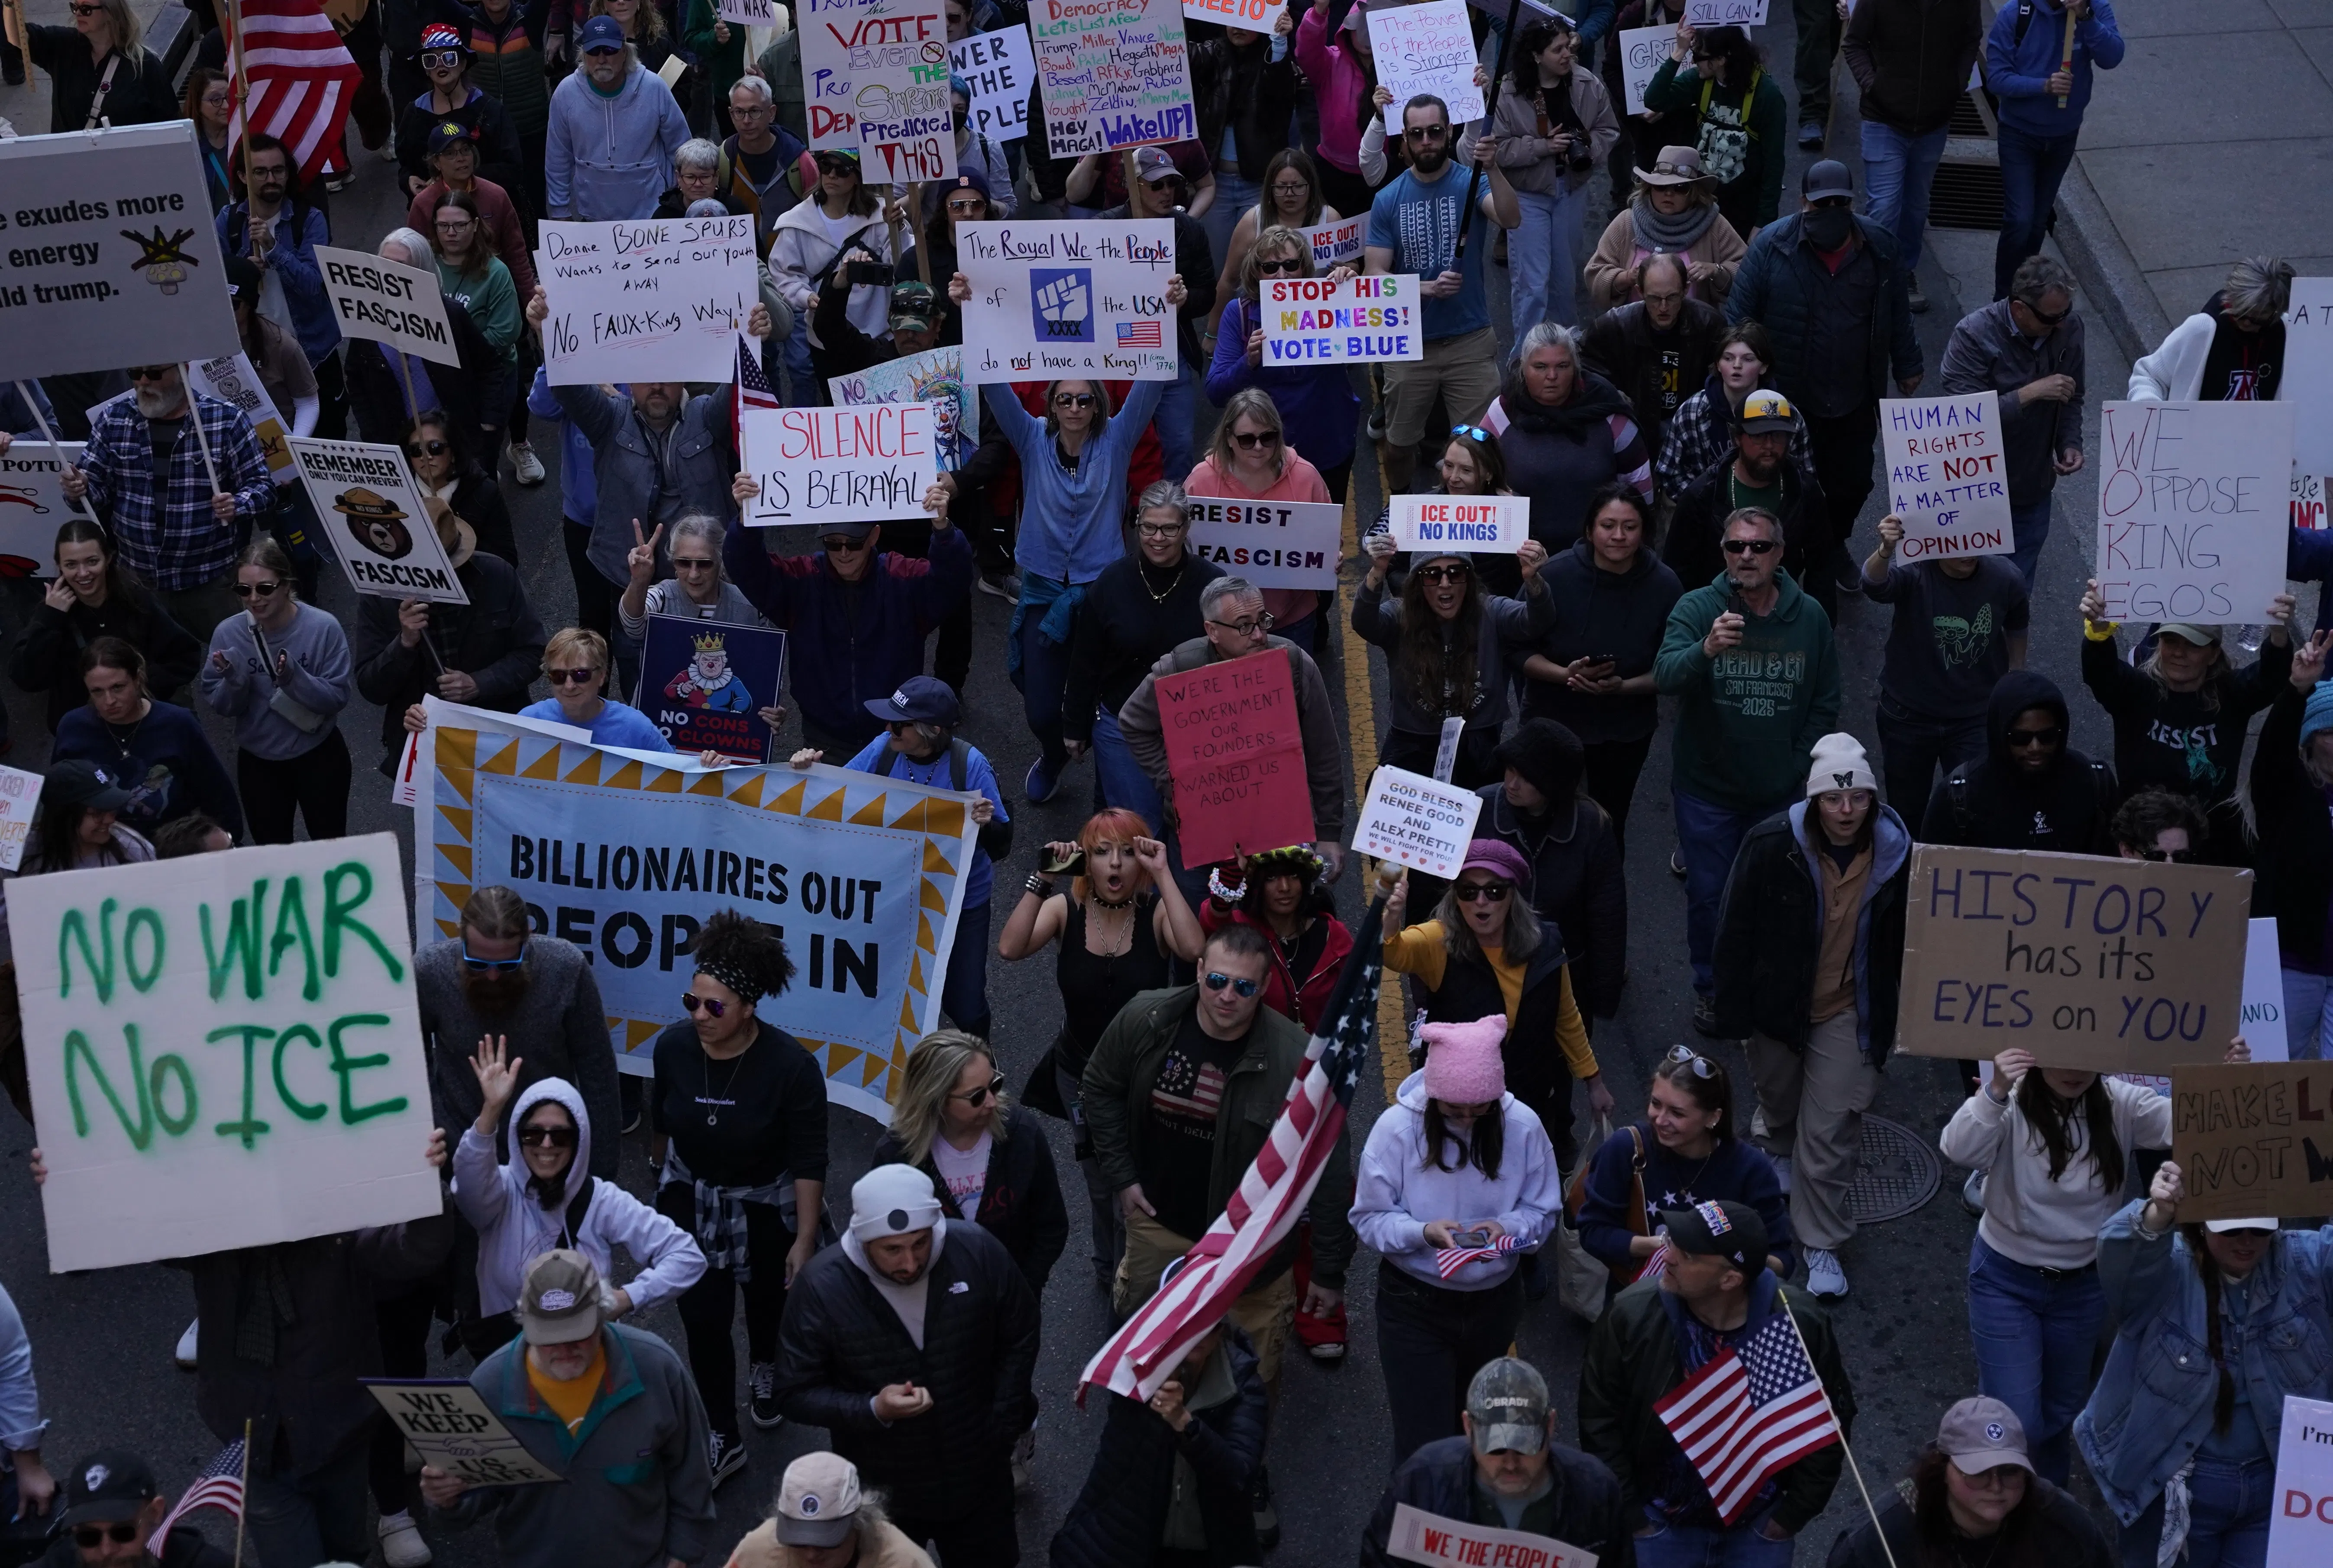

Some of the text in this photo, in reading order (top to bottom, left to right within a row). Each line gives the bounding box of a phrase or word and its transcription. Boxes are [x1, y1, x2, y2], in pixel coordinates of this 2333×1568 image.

[743, 0, 771, 19] WAR
[862, 3, 897, 16] the
[1376, 10, 1465, 33] The Power
[1691, 0, 1761, 21] STILL CAN!
[1035, 41, 1082, 56] Trump,
[1380, 31, 1470, 56] of the People
[849, 45, 920, 71] Even
[1381, 50, 1470, 74] is Stronger
[908, 62, 947, 84] THE
[965, 66, 1017, 97] THE
[1047, 68, 1095, 86] Bessent,
[1145, 74, 1182, 90] Rubio
[1383, 74, 1453, 96] than the
[856, 84, 947, 123] Simpsons
[1443, 87, 1462, 98] in
[1050, 120, 1087, 137] Hey
[1051, 131, 1102, 154] MAGA!
[15, 193, 184, 227] exudes more
[547, 219, 747, 260] Donnie BONE SPURS
[1313, 222, 1358, 247] ICE OUT!
[8, 242, 99, 267] energy
[964, 229, 1173, 271] The Royal We the People
[1313, 237, 1359, 261] NO KINGS
[555, 248, 718, 278] Wants to our
[33, 281, 120, 303] trump.
[326, 262, 414, 301] RESIST
[1272, 277, 1398, 302] STOP HIS
[986, 287, 1007, 307] of
[1102, 295, 1167, 316] the USA
[338, 298, 447, 345] FASCISM
[553, 292, 744, 359] No Way!
[1280, 306, 1409, 332] MADNESS!
[981, 348, 998, 371] do
[1011, 352, 1036, 368] not
[1041, 352, 1076, 368] have
[1084, 358, 1095, 368] a
[1150, 353, 1166, 363] (circa
[1270, 335, 1409, 360] VOTE BLUE
[201, 362, 213, 374] NO
[206, 361, 236, 380] DEMOCRACY
[211, 368, 236, 383] DEMANDS
[1156, 361, 1176, 373] 1776)
[840, 378, 866, 406] NO
[1892, 403, 1982, 431] HUMAN
[781, 407, 926, 461] SILENCE
[1908, 431, 1985, 457] RIGHTS
[2102, 407, 2190, 471] WE
[300, 452, 401, 477] REMEMBER
[1894, 454, 1999, 483] ARE NOT
[309, 471, 404, 488] ONLY YOU CAN PREVENT
[760, 464, 923, 510] IS BETRAYAL
[1896, 481, 2004, 513] A MATTER
[2104, 469, 2260, 516] OPPOSE
[355, 504, 383, 514] NO KINGS
[1192, 503, 1292, 527] RESIST
[1422, 504, 1496, 524] ICE OUT!
[1937, 510, 1960, 526] OF
[1419, 523, 1497, 542] NO KINGS
[1903, 529, 2002, 558] OPINION
[1199, 544, 1324, 570] FASCISM
[2104, 522, 2221, 571] KING
[349, 559, 452, 591] FASCISM
[2102, 581, 2232, 619] EGOS
[1232, 668, 1266, 689] THE
[1725, 679, 1794, 700] SAN FRANCISCO
[1174, 687, 1284, 729] GOVERNMENT
[1742, 697, 1775, 718] 2025
[661, 710, 749, 733] NO CONS
[1212, 722, 1239, 738] OUR
[679, 730, 762, 751] CLOWNS
[1193, 731, 1276, 761] FOUNDERS
[1175, 760, 1280, 793] WARNED US
[1200, 781, 1264, 809] ABOUT
[1389, 782, 1464, 813] GOD BLESS
[1379, 793, 1465, 828] RENEE GOOD
[1403, 816, 1432, 831] AND
[1371, 820, 1456, 854] ALEX PRETTI
[1380, 835, 1397, 845] WILL
[1398, 841, 1419, 852] FIGHT
[1420, 848, 1434, 857] FOR
[1436, 852, 1453, 863] YOU!
[511, 834, 882, 924] BILLIONAIRES OUT
[1931, 867, 2214, 939] HISTORY
[58, 861, 404, 1006] NO WAR
[808, 933, 878, 1000] IN
[2005, 929, 2156, 982] has its
[1933, 979, 2207, 1041] EYES on YOU
[205, 1013, 409, 1151] ICE
[2178, 1081, 2292, 1133] MAKE
[2191, 1137, 2292, 1197] NOT
[397, 1392, 464, 1414] WE
[398, 1412, 490, 1434] KEEP
[1425, 1528, 1565, 1568] WE THE PEOPLE
